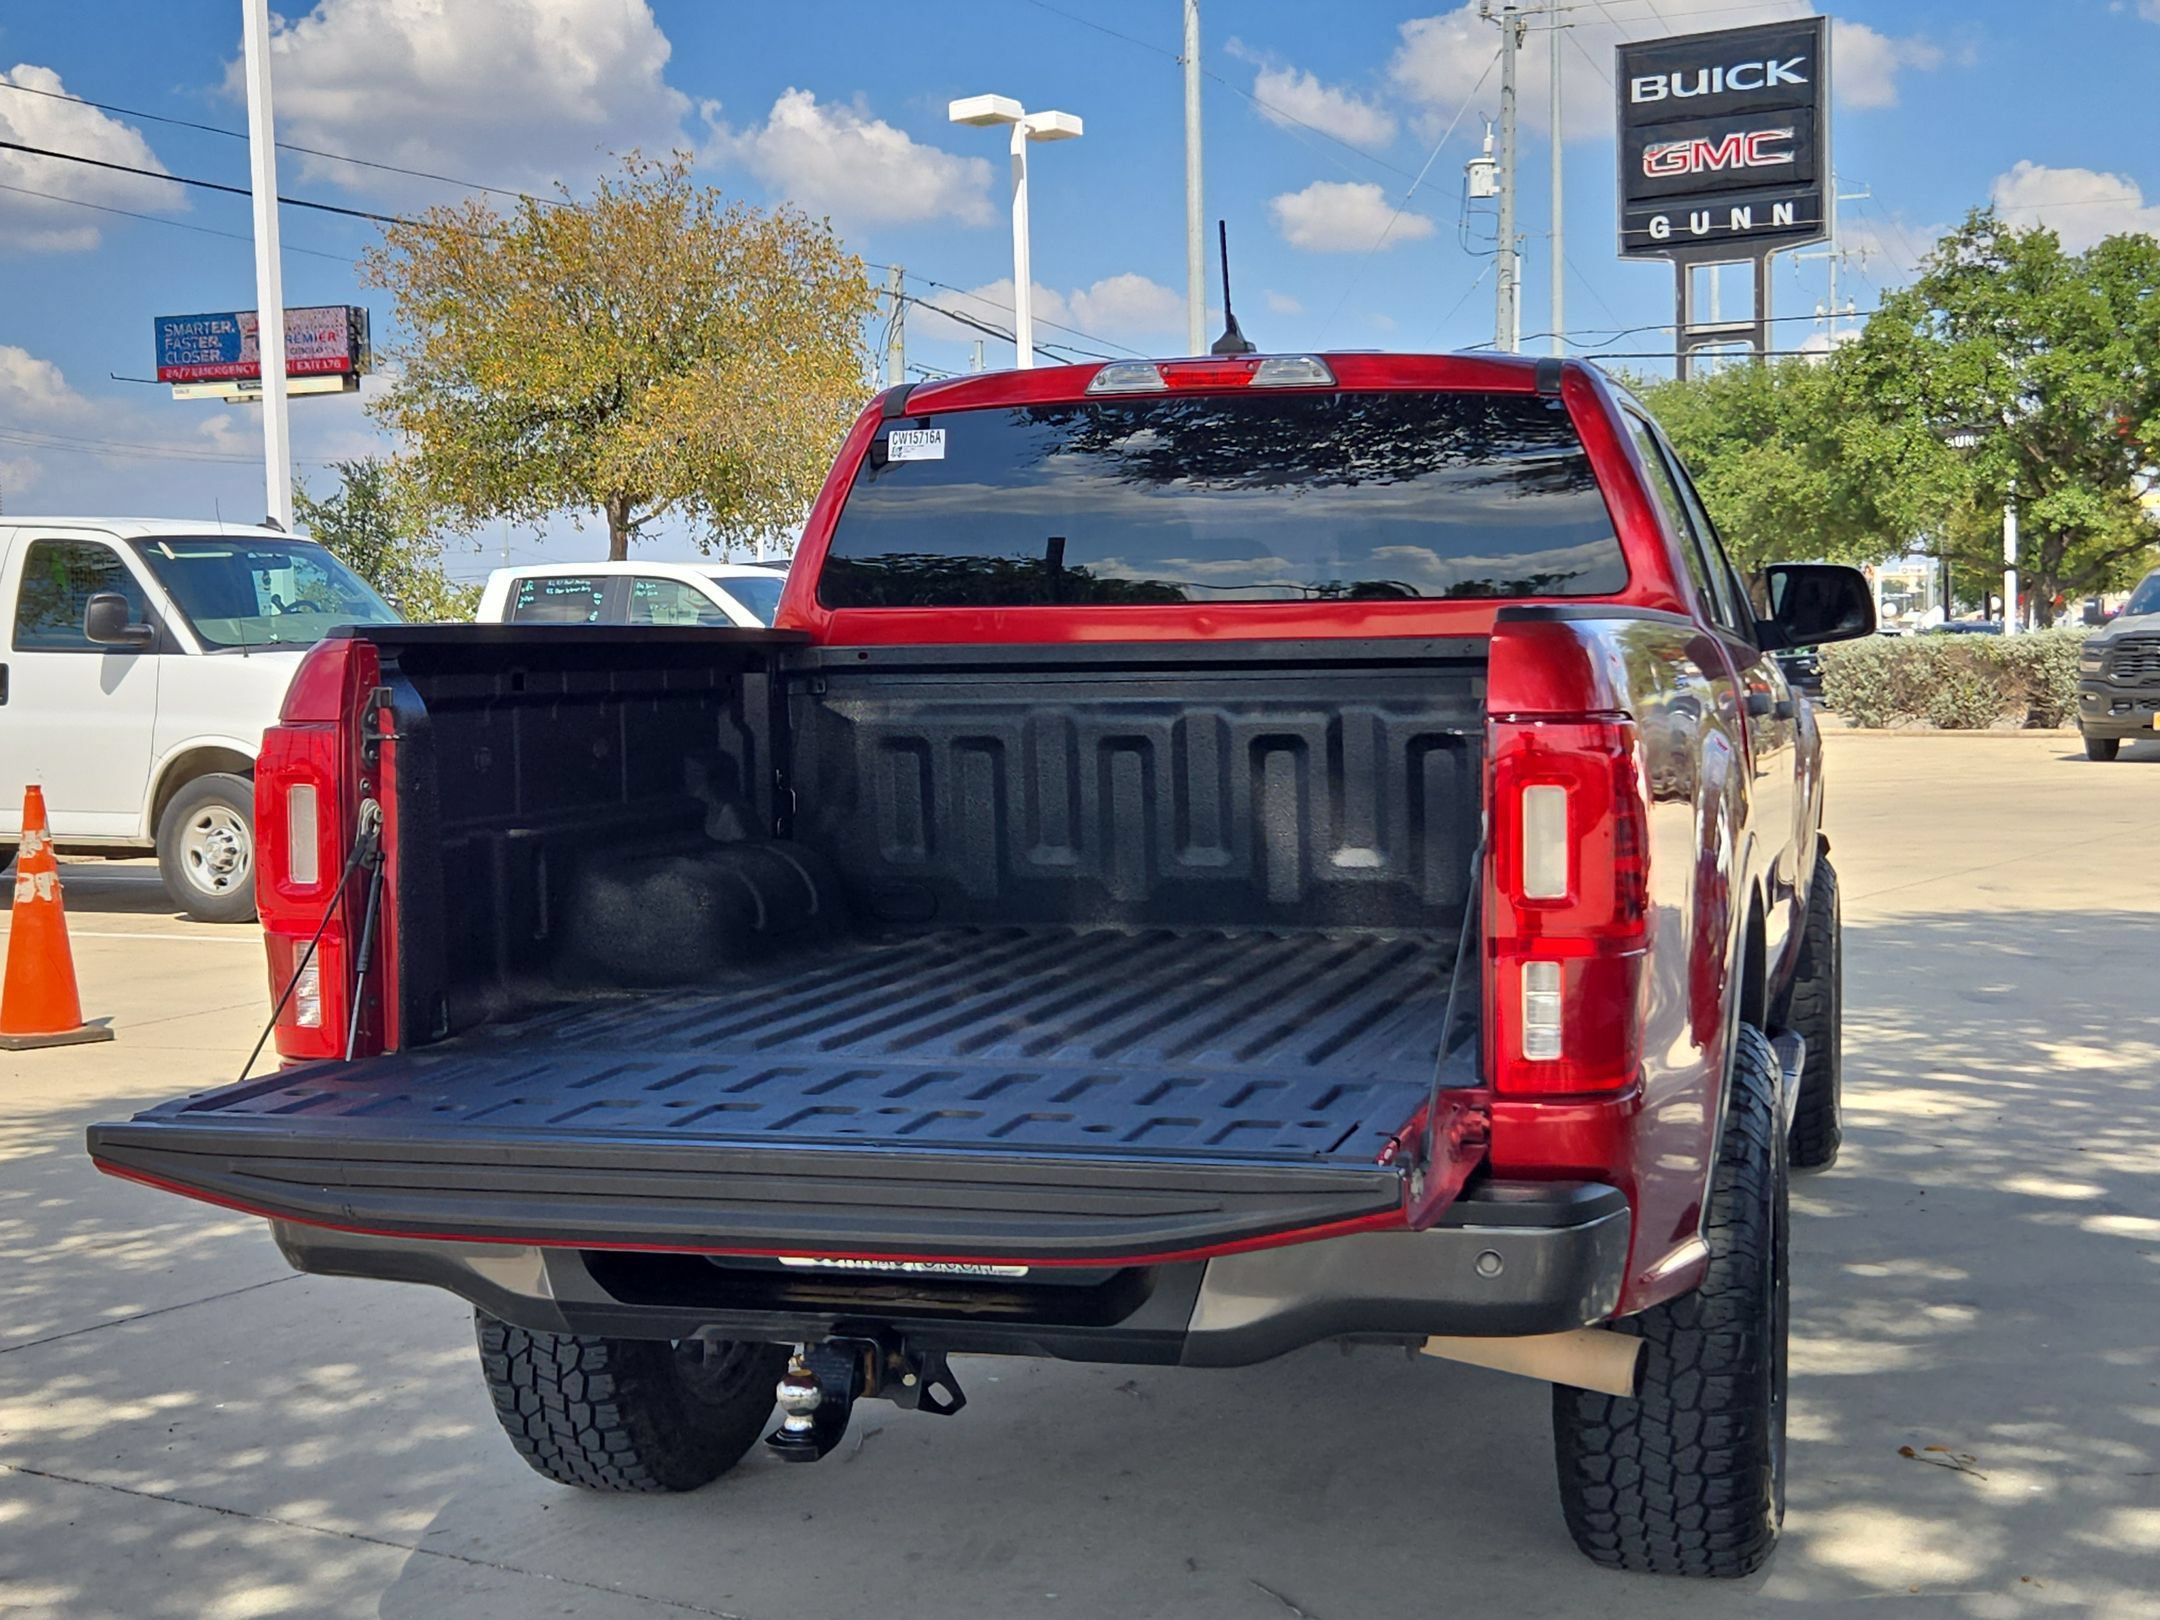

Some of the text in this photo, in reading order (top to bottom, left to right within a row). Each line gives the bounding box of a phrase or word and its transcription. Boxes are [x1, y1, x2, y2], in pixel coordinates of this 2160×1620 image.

[1631, 57, 1808, 103] BUICK
[1642, 126, 1795, 178] GMC
[1649, 202, 1794, 239] GUNN
[164, 320, 235, 337] SMARTER.
[165, 335, 222, 351] FASTER.
[285, 331, 337, 344] REMIER
[165, 349, 224, 365] CLOSER.
[191, 364, 256, 377] EMERGENCY
[296, 359, 320, 371] EXIT
[892, 431, 941, 446] CW15716A
